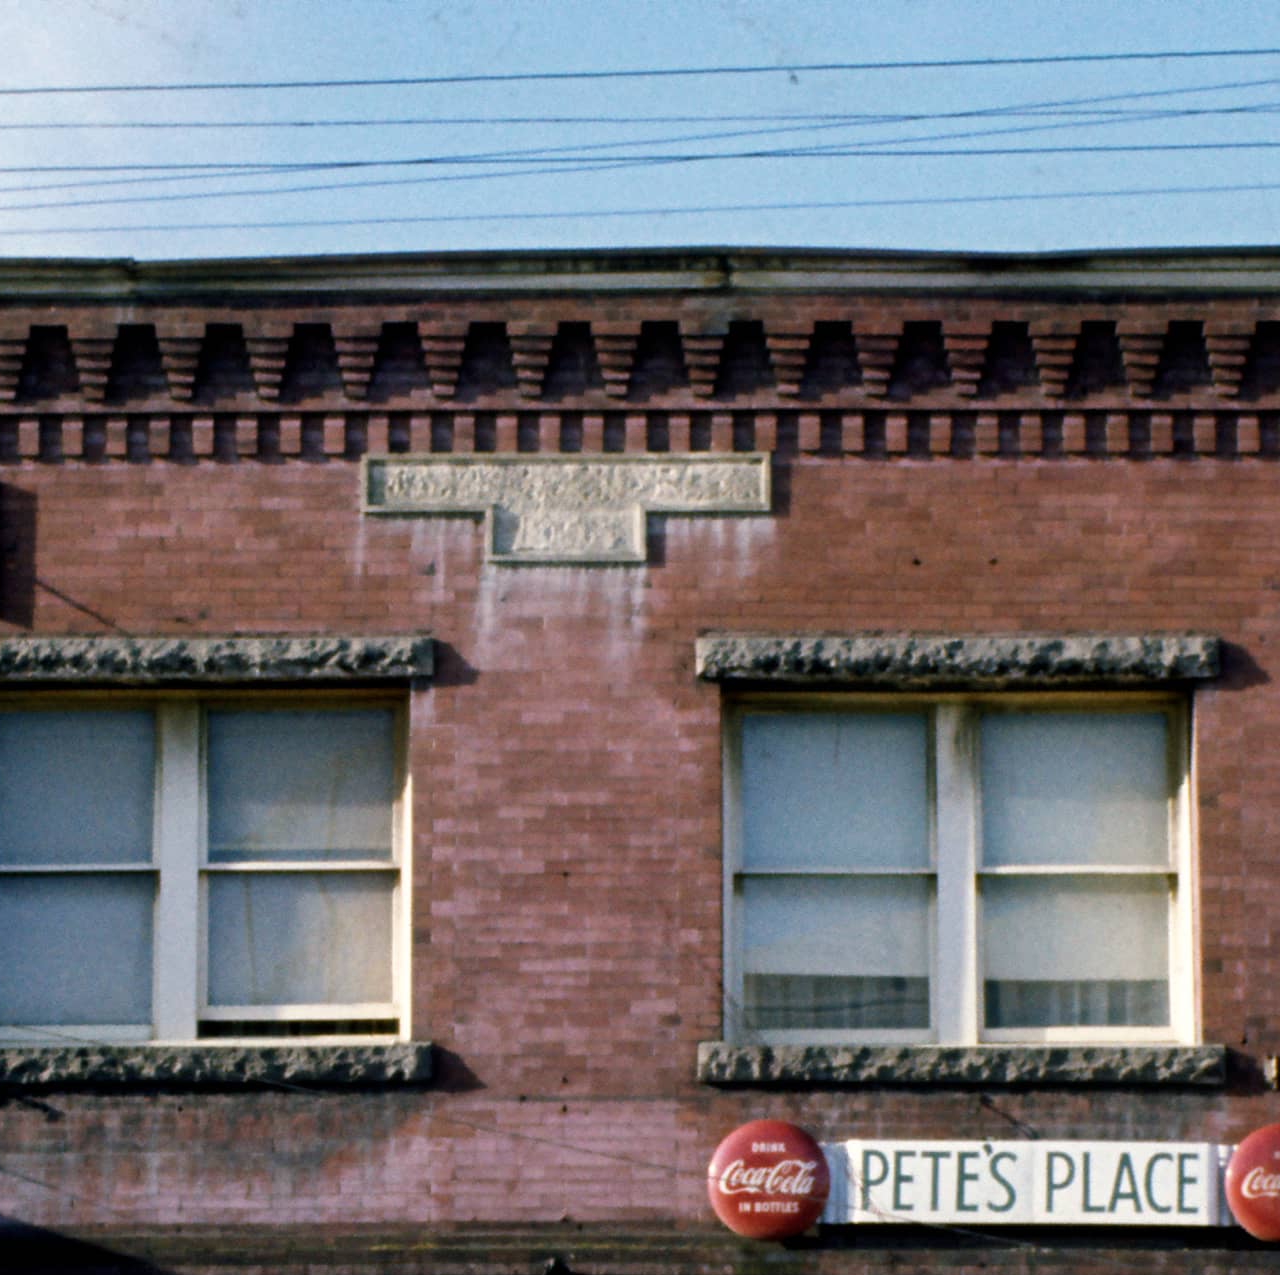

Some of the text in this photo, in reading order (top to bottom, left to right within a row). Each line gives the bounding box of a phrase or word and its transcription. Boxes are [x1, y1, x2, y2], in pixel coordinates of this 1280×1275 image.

[751, 1141, 786, 1153] DRINK
[718, 1157, 819, 1196] Coca-Cola
[862, 1143, 1199, 1215] PETE'S PLACE
[738, 1201, 800, 1214] IN BOTTLES
